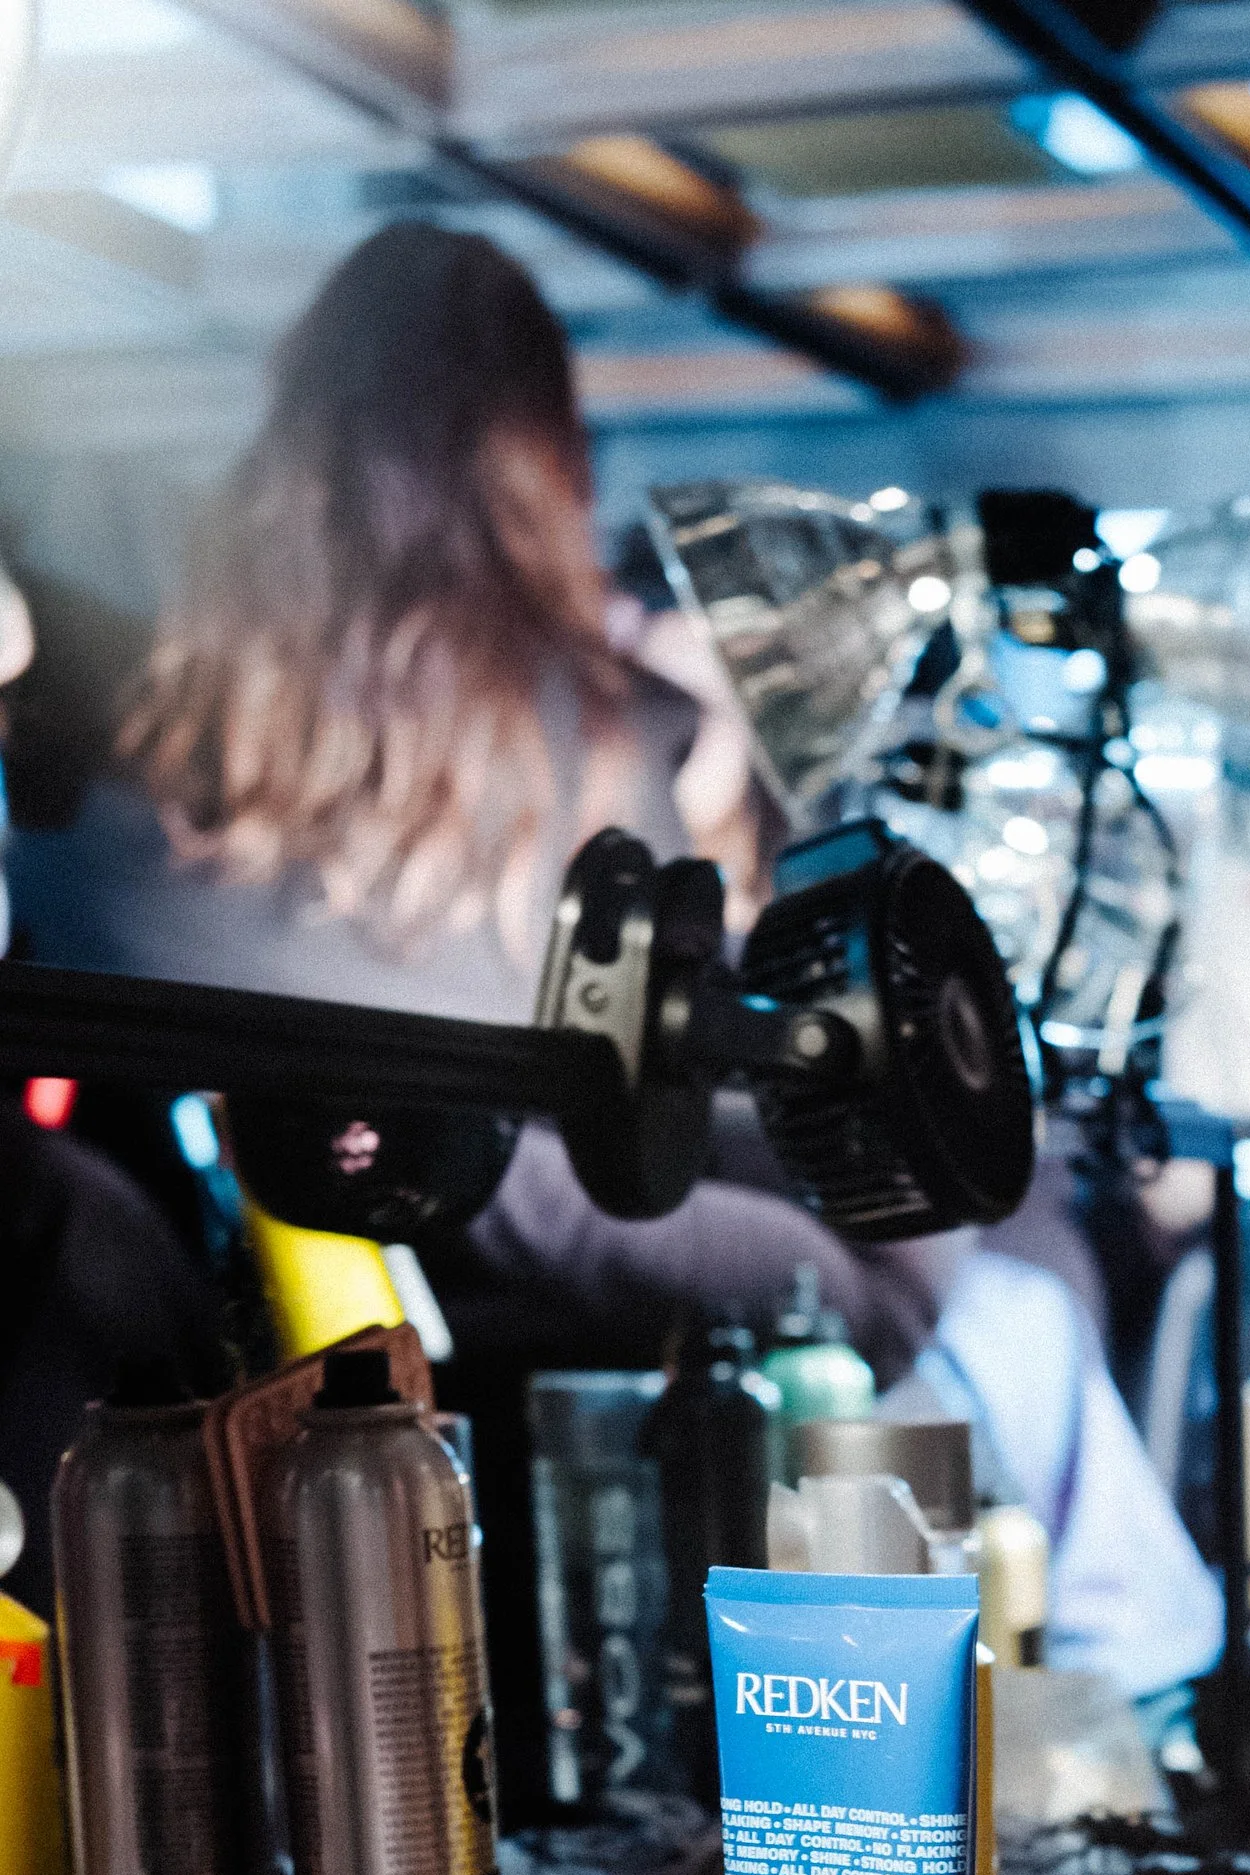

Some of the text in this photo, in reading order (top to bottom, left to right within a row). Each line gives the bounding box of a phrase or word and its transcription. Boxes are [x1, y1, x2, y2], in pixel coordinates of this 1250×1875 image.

[736, 1673, 908, 1725] REDKEN
[765, 1723, 877, 1741] 5TH AVENUE NYC
[744, 1800, 784, 1815] HOLD
[792, 1804, 819, 1817] ALL
[821, 1805, 847, 1819] DAY
[849, 1808, 908, 1827] CONTROL
[918, 1814, 967, 1827] SHINE
[783, 1818, 831, 1833] SHAPE
[835, 1822, 890, 1840] MEMORY
[737, 1832, 761, 1843] ALL
[765, 1833, 796, 1846] DAY
[801, 1835, 866, 1852] CONTROL
[873, 1842, 892, 1856] NO
[737, 1845, 799, 1861] MEMORY
[810, 1851, 851, 1866] SHINE
[861, 1856, 916, 1873] STRONG
